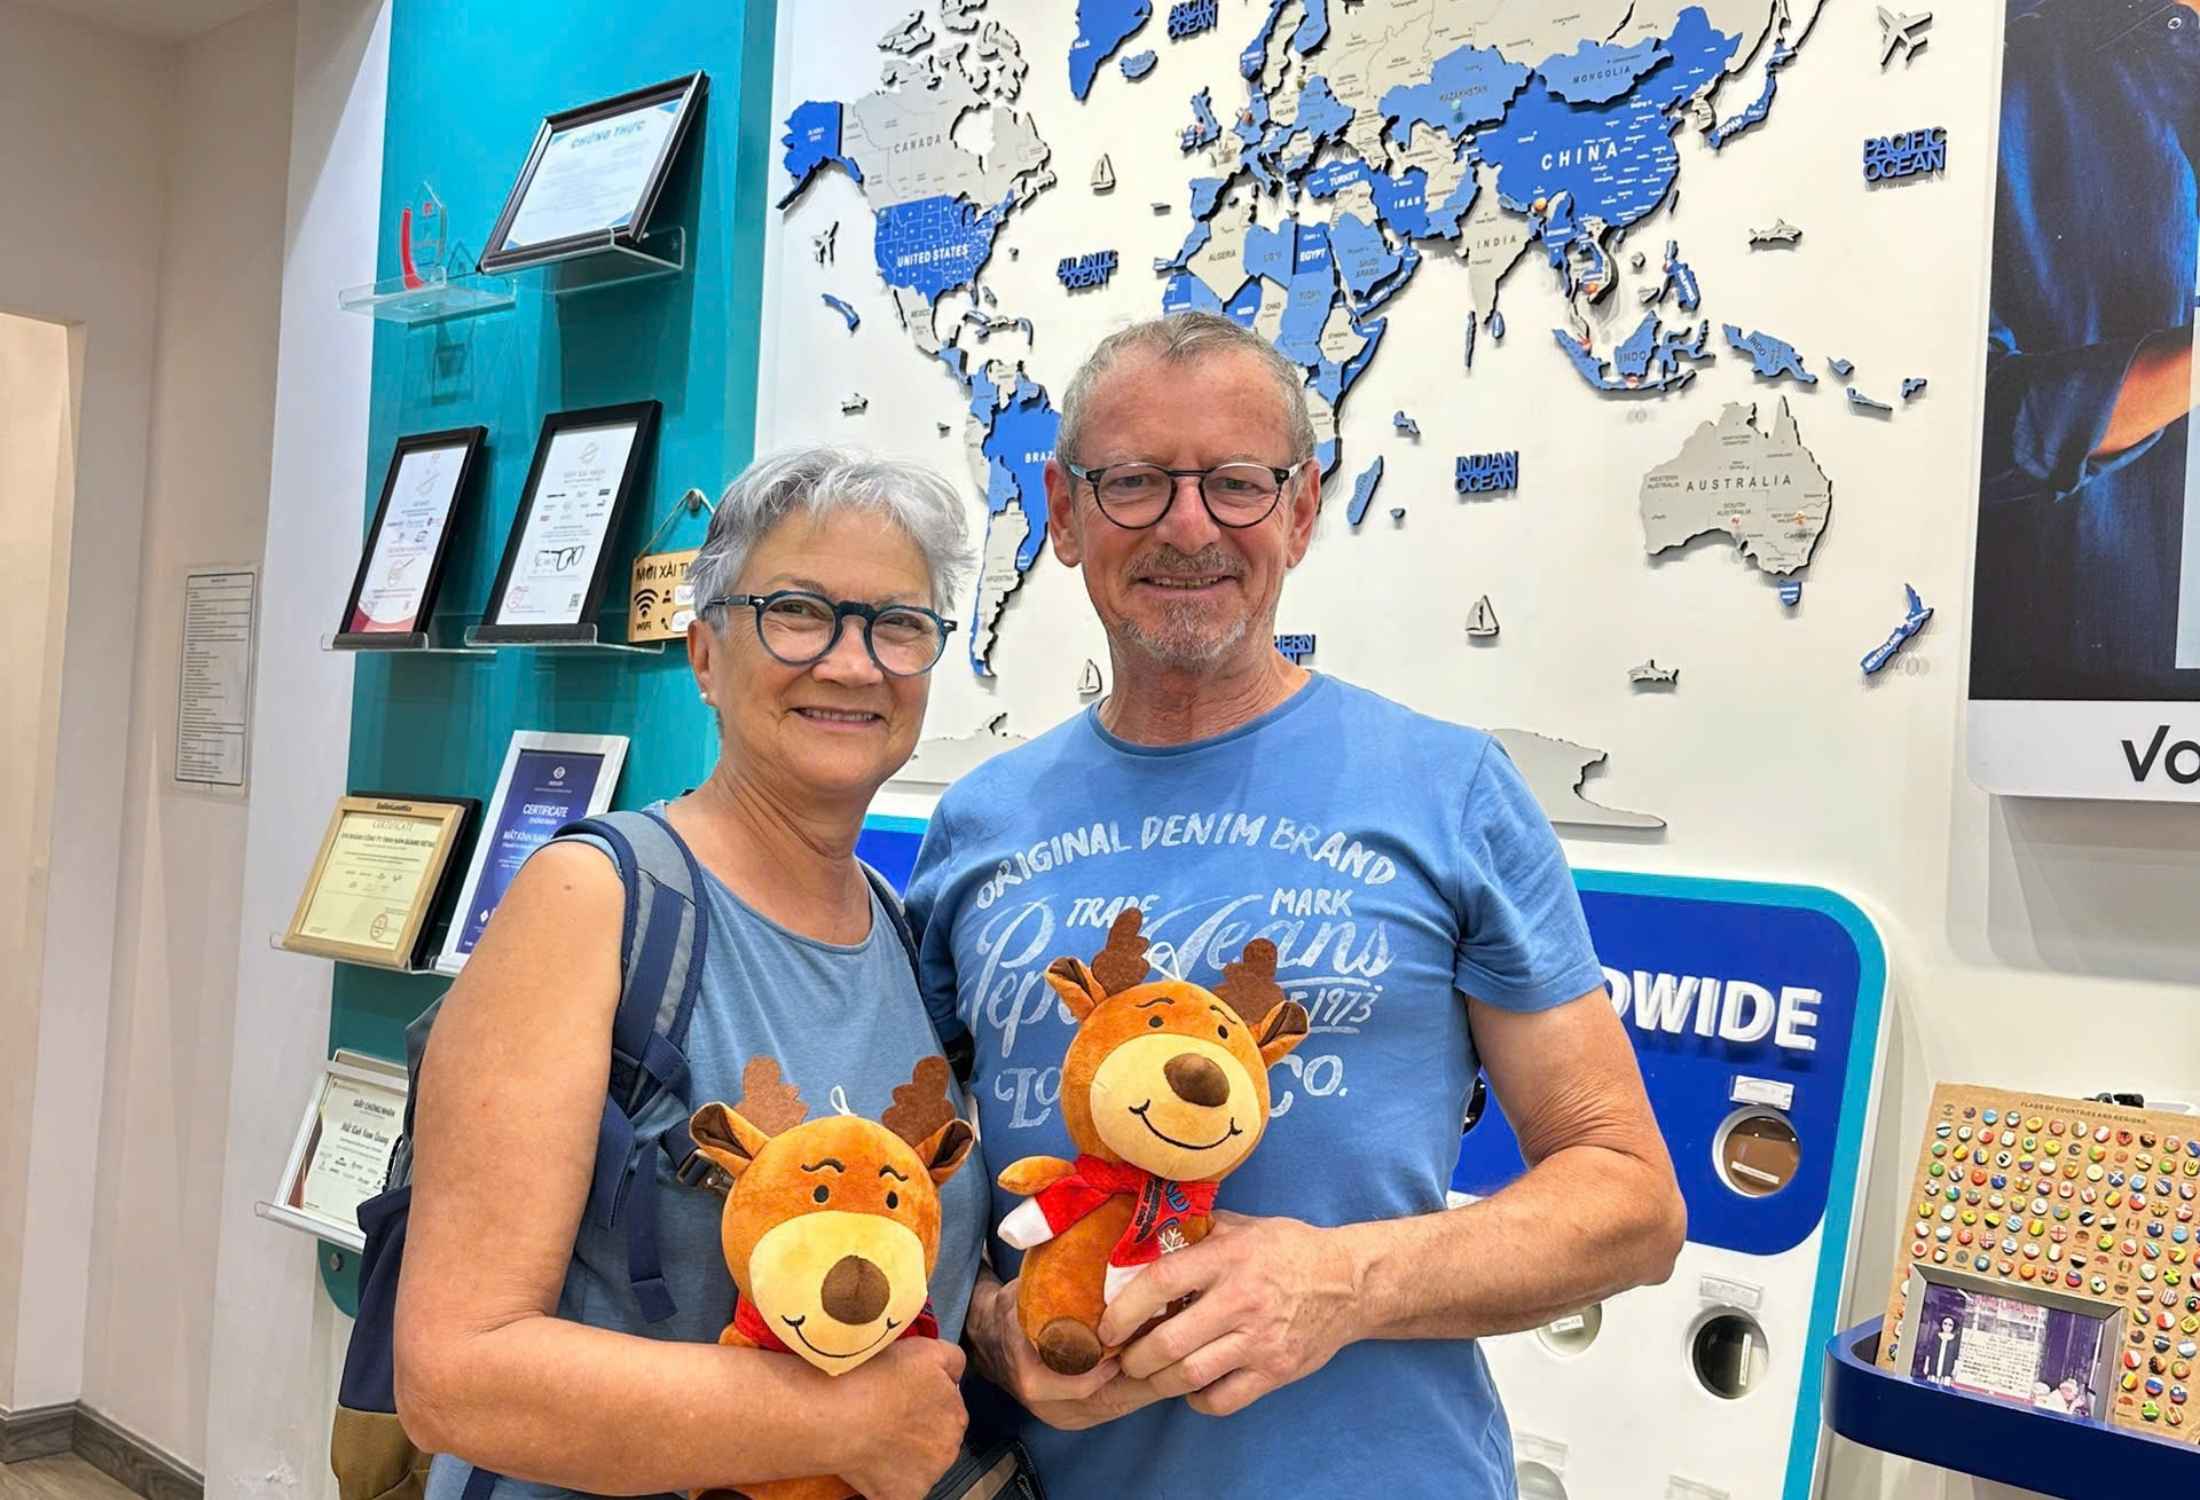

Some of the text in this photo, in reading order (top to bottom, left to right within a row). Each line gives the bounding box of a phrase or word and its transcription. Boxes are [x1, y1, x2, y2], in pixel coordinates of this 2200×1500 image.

[1168, 11, 1218, 40] OCEAN
[1573, 66, 1632, 84] MONGOLIA
[894, 134, 942, 154] CANADA
[1864, 126, 1947, 163] PACIFIC
[1541, 142, 1619, 171] CHINA
[1863, 145, 1947, 182] OCEAN
[1329, 169, 1360, 187] TURKEY
[1393, 196, 1421, 210] IRAN
[1477, 234, 1517, 249] INDIA
[897, 244, 969, 267] UNITED STATES
[1057, 250, 1118, 276] ATLANTIC
[1300, 248, 1327, 262] EGYPT
[1064, 269, 1109, 289] OCEAN
[1025, 452, 1056, 464] BRAZ
[1456, 450, 1519, 474] INDIAN
[1455, 472, 1518, 495] OCEAN
[1686, 475, 1792, 493] AUSTRALIA
[523, 803, 568, 818] CERTIFICATE
[976, 813, 1397, 910] ORIGINAL DENIM BRAND
[1269, 888, 1353, 917] MARK
[1310, 987, 1379, 1026] 1973
[1601, 965, 1822, 1051] DWIDE
